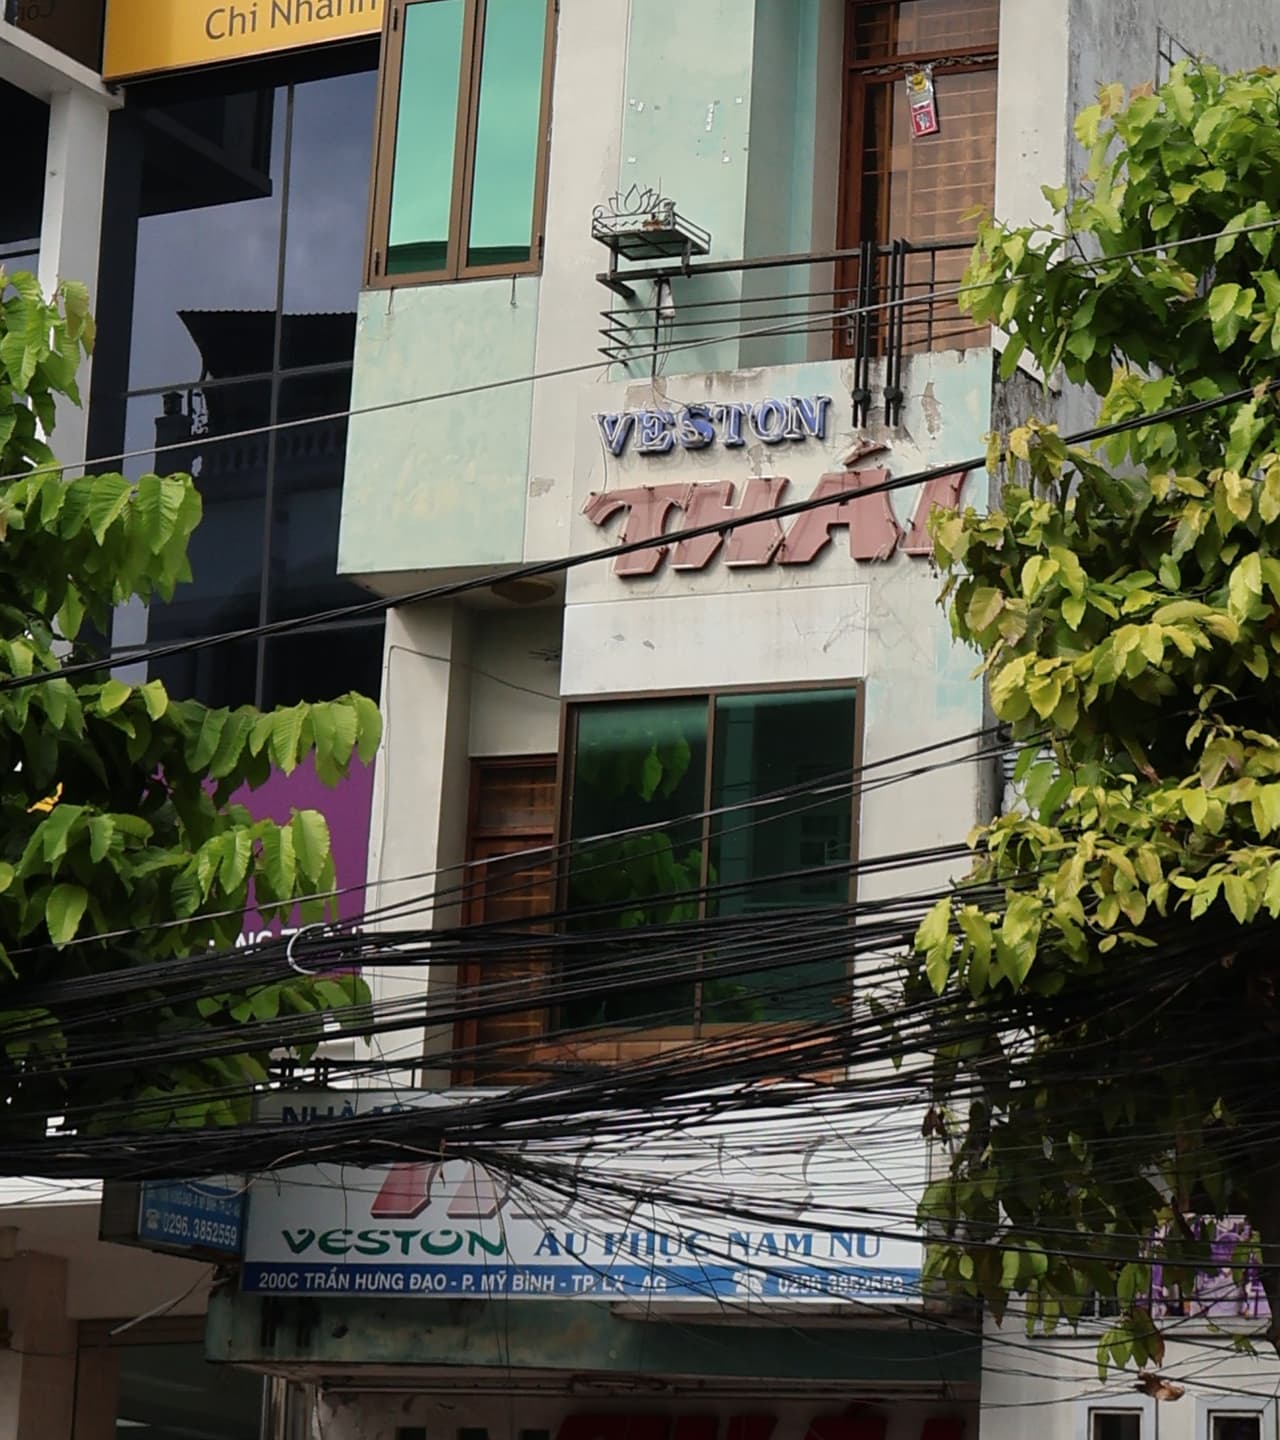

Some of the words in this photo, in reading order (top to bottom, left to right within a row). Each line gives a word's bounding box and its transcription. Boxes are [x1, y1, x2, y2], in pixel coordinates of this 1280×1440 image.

[205, 2, 257, 40] Chi
[593, 395, 831, 456] VESTON
[282, 1229, 505, 1256] VESTON
[728, 1232, 813, 1257] NAM
[259, 1272, 299, 1289] 200C
[410, 1273, 447, 1293] ĐẠO
[462, 1274, 475, 1290] P.
[481, 1270, 508, 1291] MỸ
[512, 1270, 555, 1292] BÌNH
[639, 1274, 667, 1292] AG
